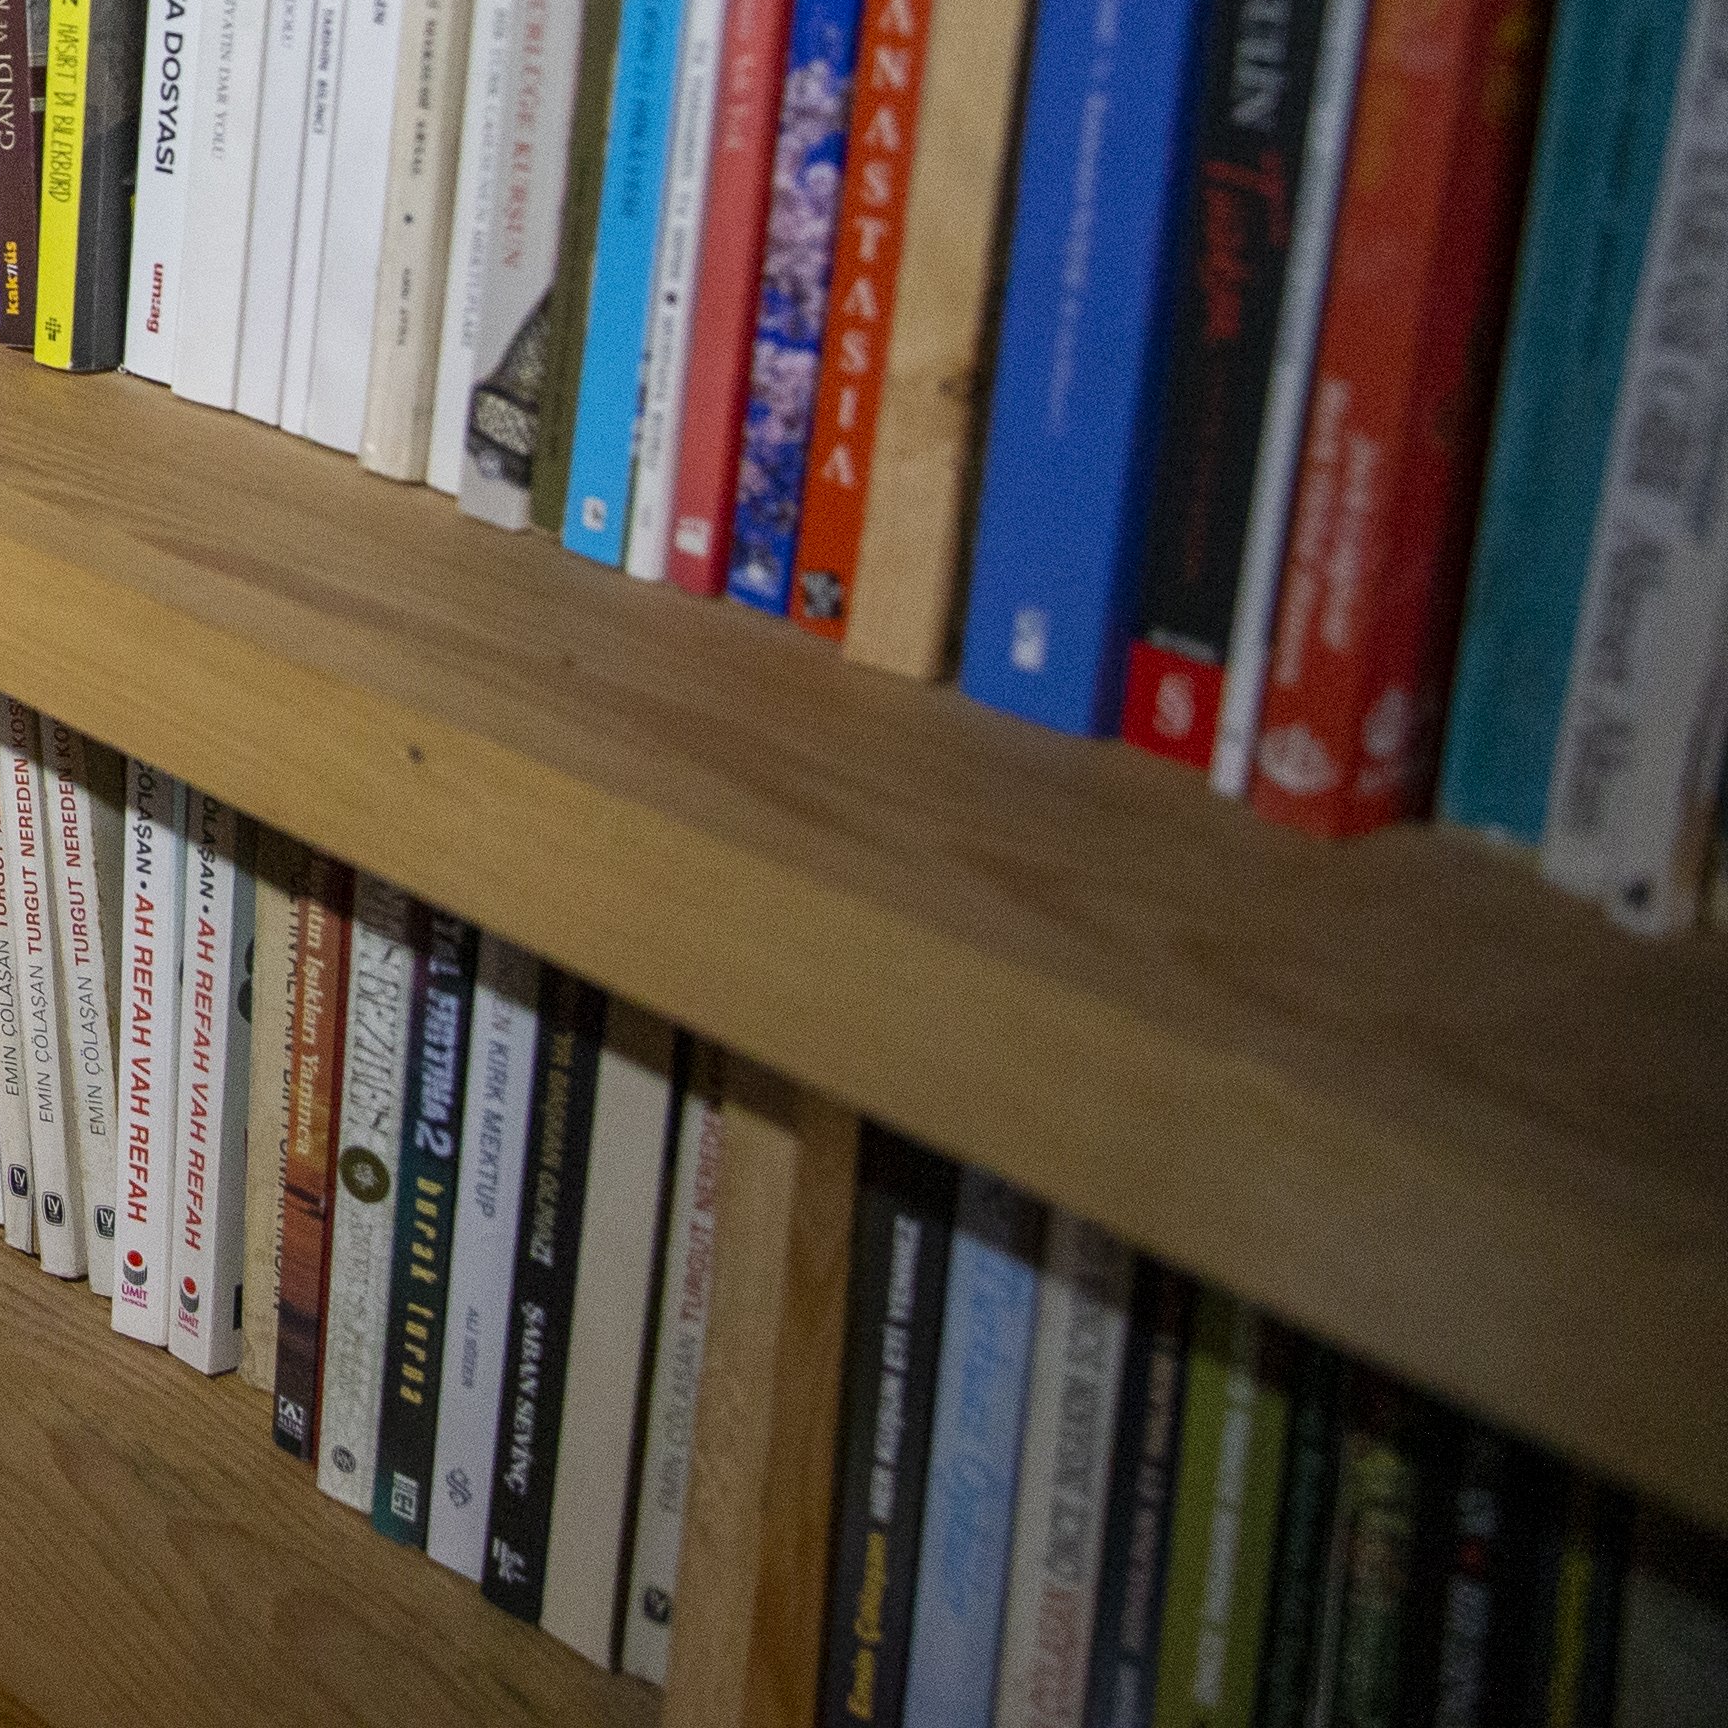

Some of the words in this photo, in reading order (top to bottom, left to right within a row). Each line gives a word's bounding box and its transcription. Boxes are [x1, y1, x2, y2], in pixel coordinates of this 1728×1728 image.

[154, 31, 183, 175] DOSYASI
[134, 894, 154, 937] AH
[132, 944, 153, 1048] REFAH
[130, 1056, 151, 1117] VAH
[127, 1123, 150, 1223] REFAH
[411, 1175, 444, 1285] burak
[399, 1302, 435, 1405] turna
